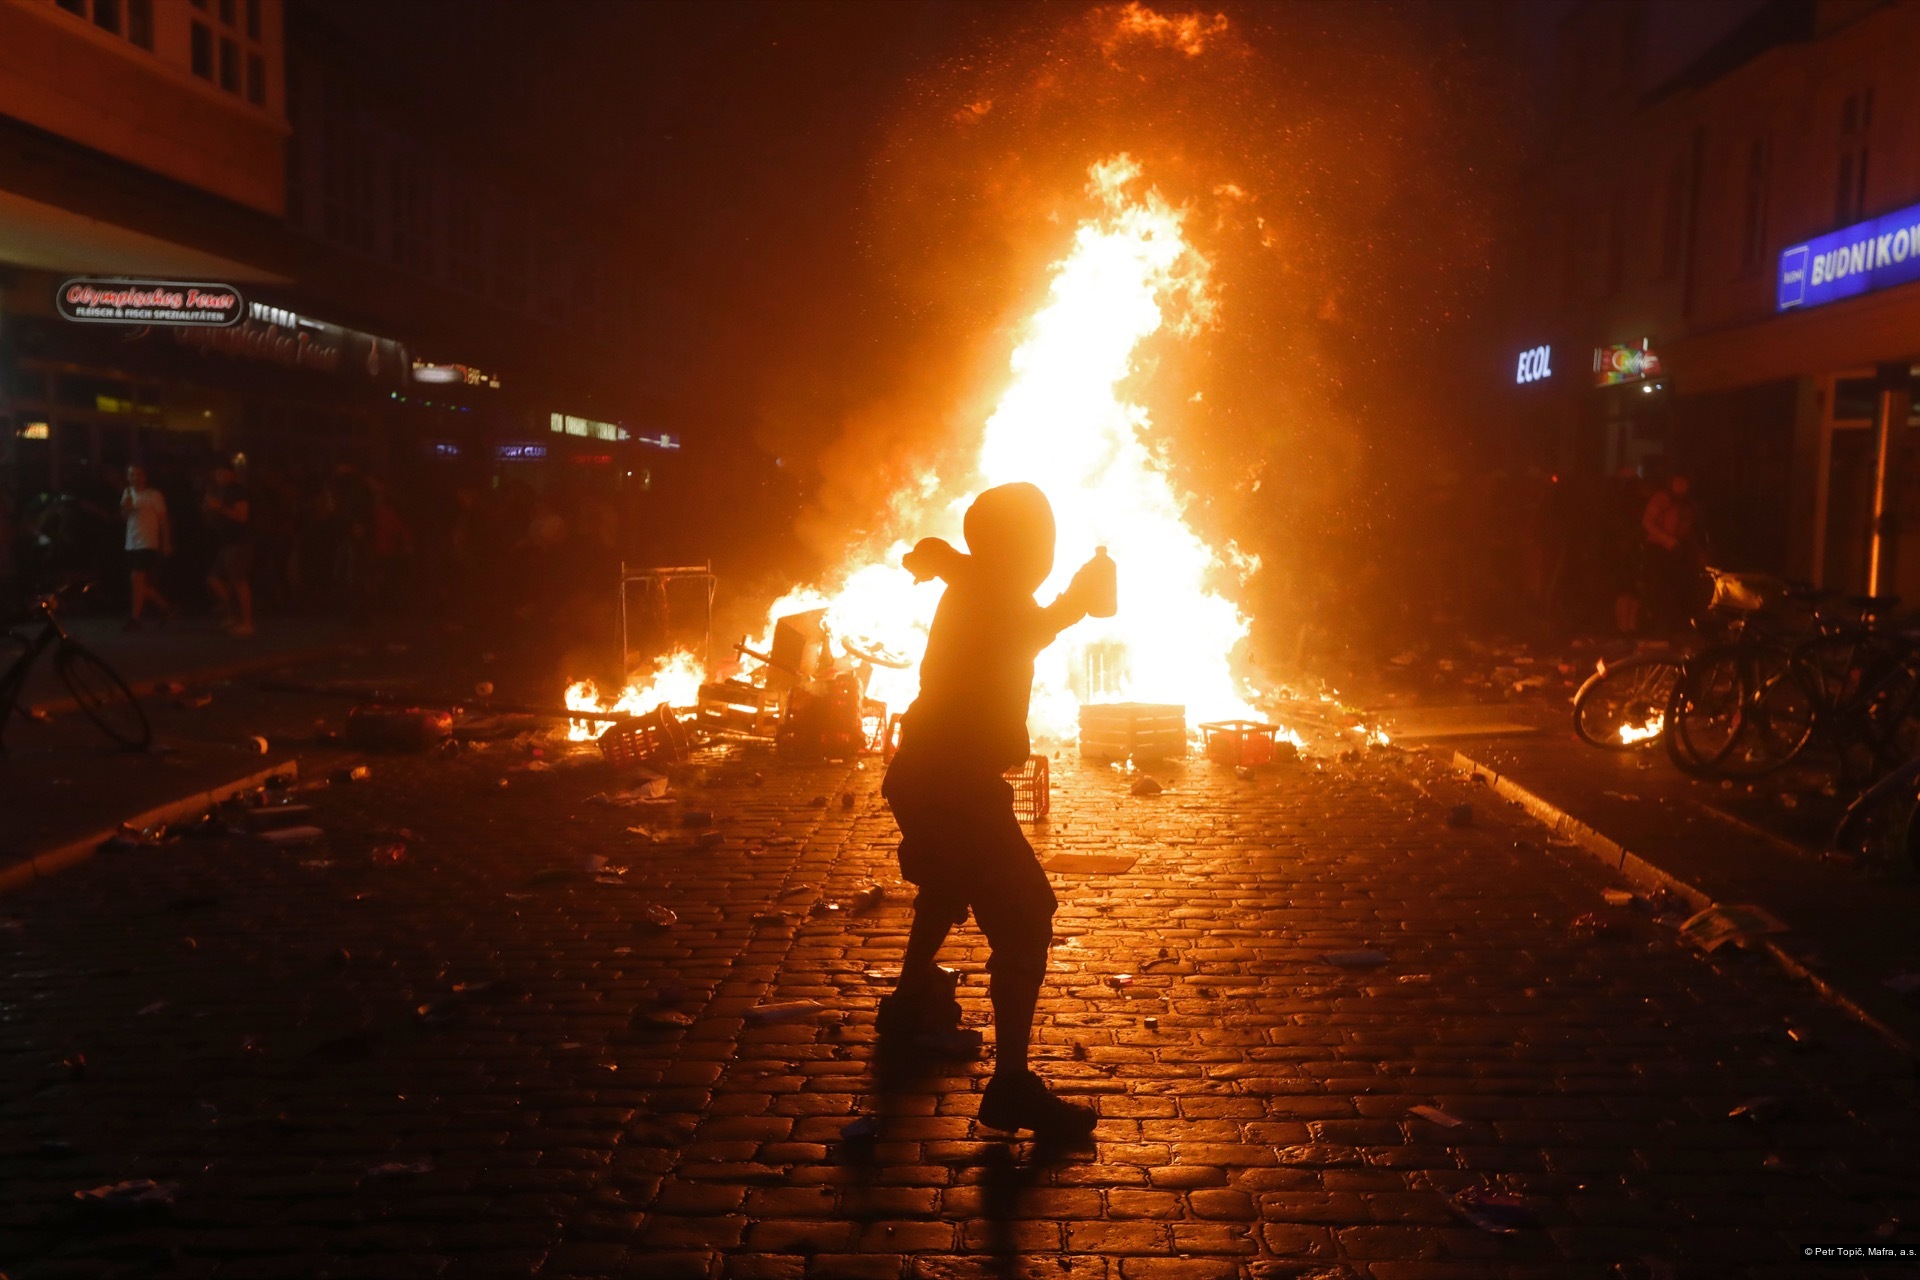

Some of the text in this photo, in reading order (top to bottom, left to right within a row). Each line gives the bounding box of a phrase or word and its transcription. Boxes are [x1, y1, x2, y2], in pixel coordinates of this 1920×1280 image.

[66, 285, 235, 309] Olympisches Feuer
[76, 307, 225, 321] FLEISCH & FISCH SPEZIALITÄTEN
[1516, 345, 1552, 384] ECOL
